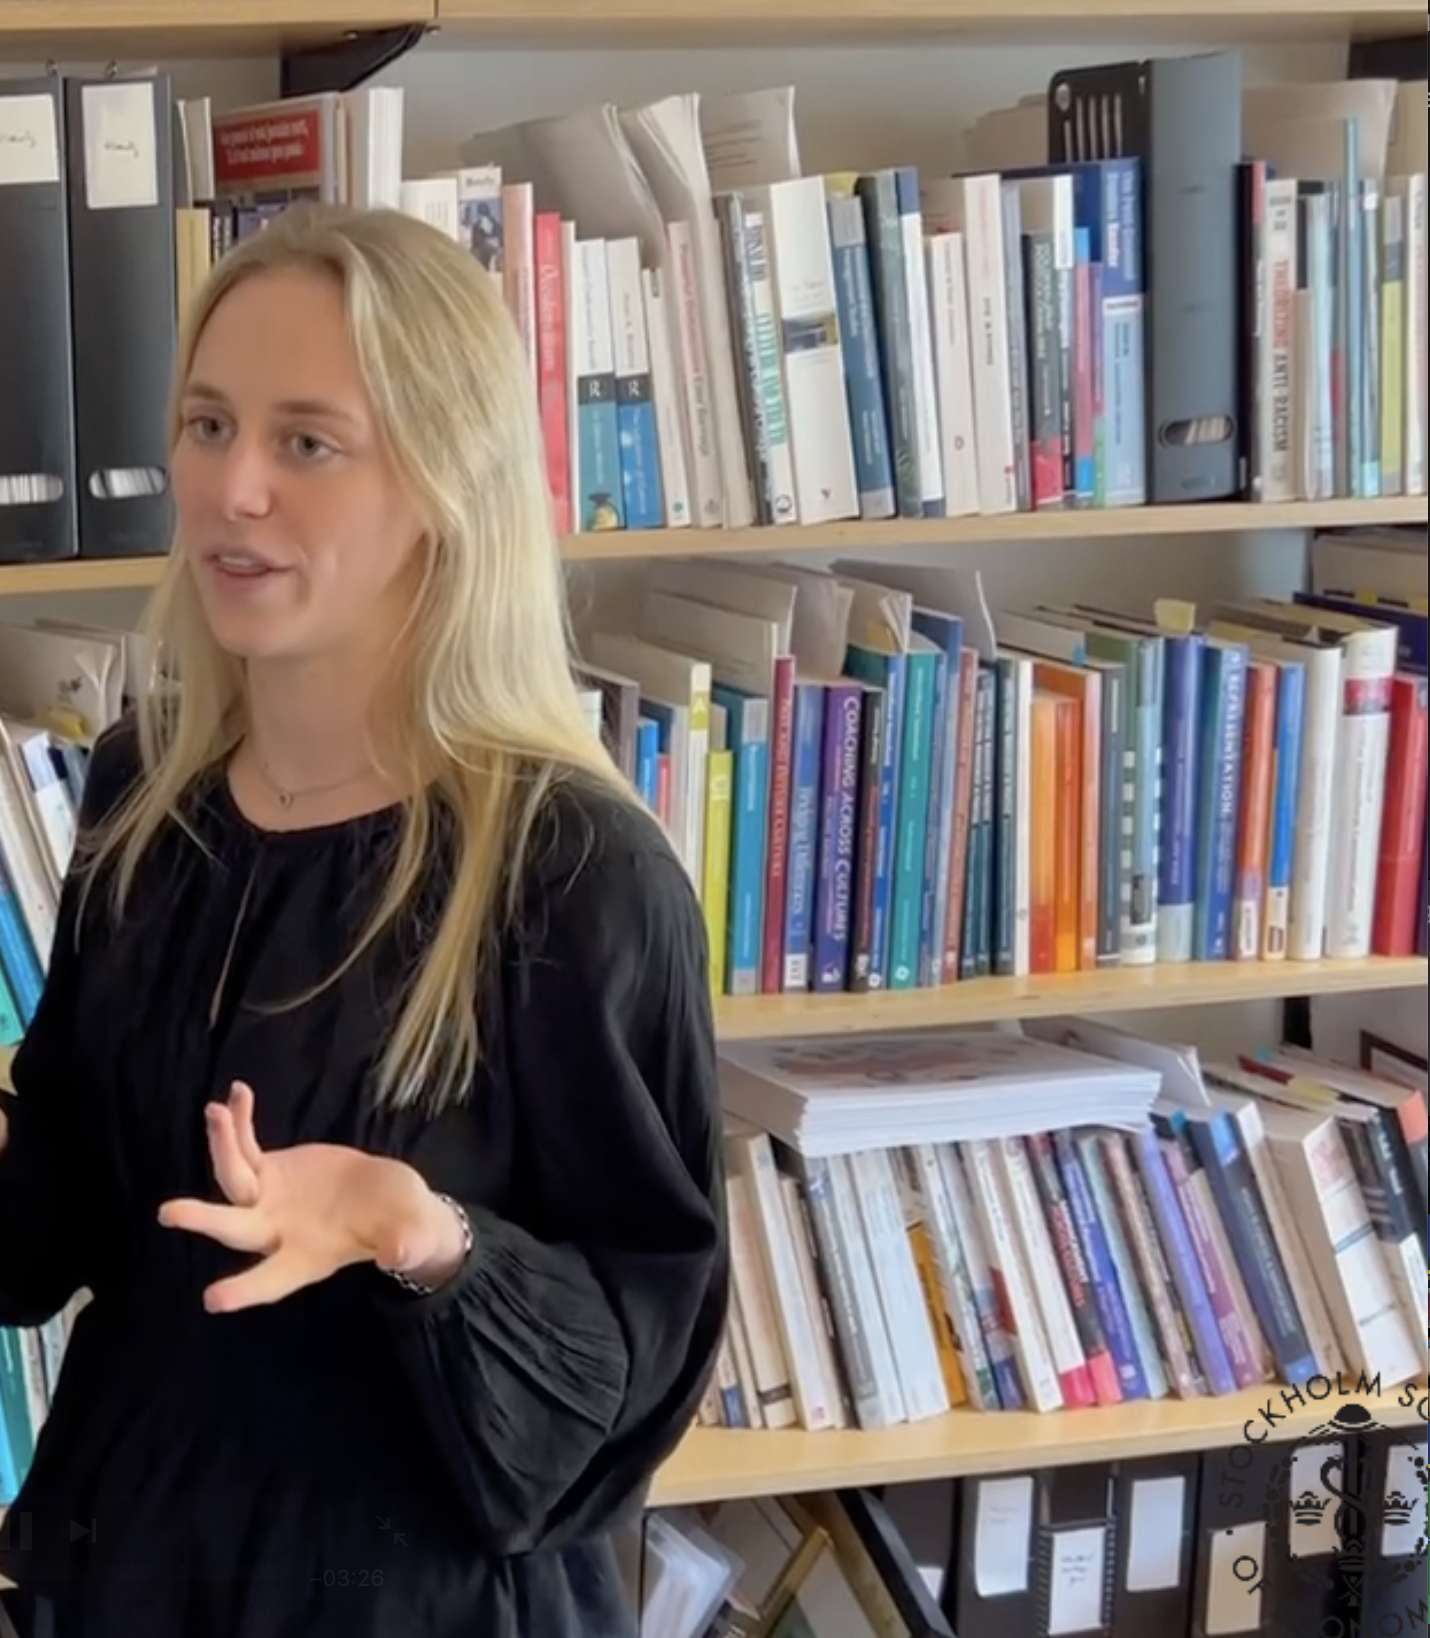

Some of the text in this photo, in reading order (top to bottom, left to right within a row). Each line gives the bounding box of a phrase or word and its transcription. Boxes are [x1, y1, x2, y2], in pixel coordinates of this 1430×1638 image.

[1271, 260, 1290, 452] THEORIZING ANTI-RACISM
[830, 697, 861, 941] COACHING ACROSS CULTURES
[1221, 669, 1241, 812] REPRESENTATION
